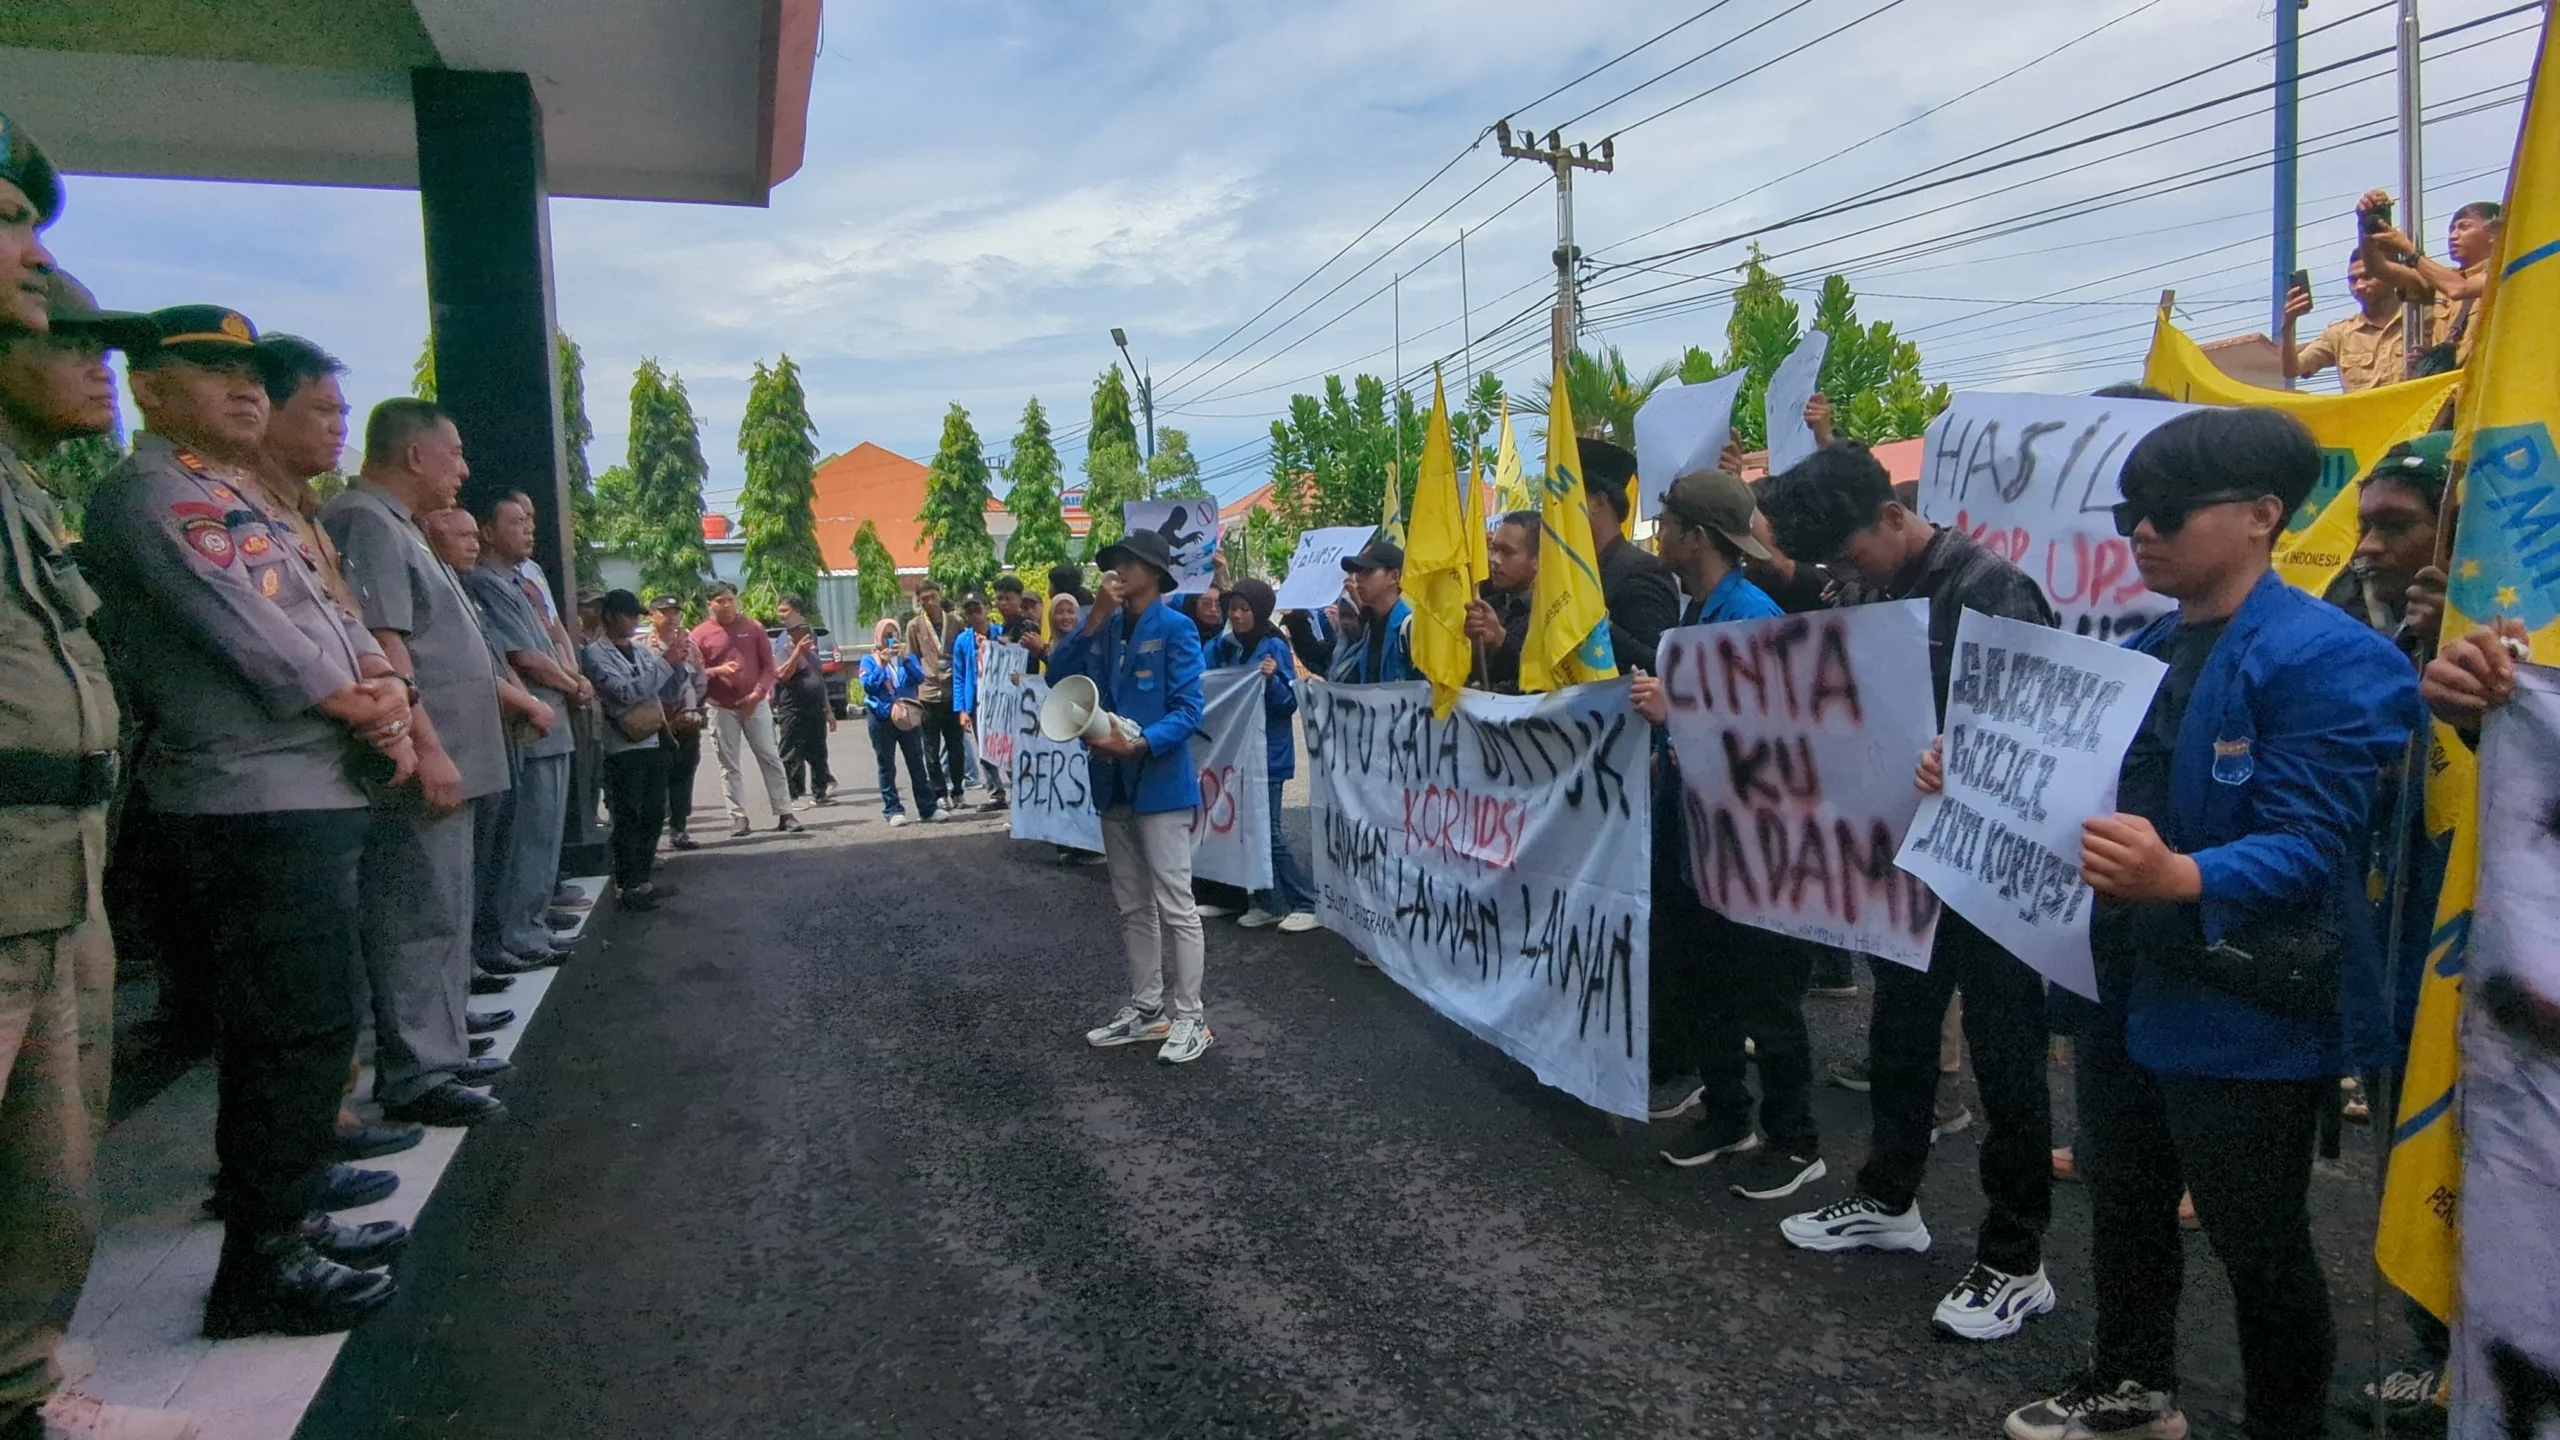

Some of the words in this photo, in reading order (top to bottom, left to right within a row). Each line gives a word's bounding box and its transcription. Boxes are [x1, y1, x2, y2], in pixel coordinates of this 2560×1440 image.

[1934, 410, 2129, 514] HASIL
[1664, 617, 1865, 725] CINTA
[1018, 750, 1092, 815] BERS
[1388, 697, 1459, 789] KATA
[1466, 710, 1630, 820] UNTUK
[1722, 728, 1822, 805] KU
[1403, 785, 1526, 878] KORUPSI
[1686, 786, 1942, 936] PADAMU
[1911, 796, 1985, 876] ANTI
[1325, 804, 1388, 900] LAWAN
[1395, 857, 1503, 984] LAWAN
[1520, 883, 1633, 1059] LAWAN
